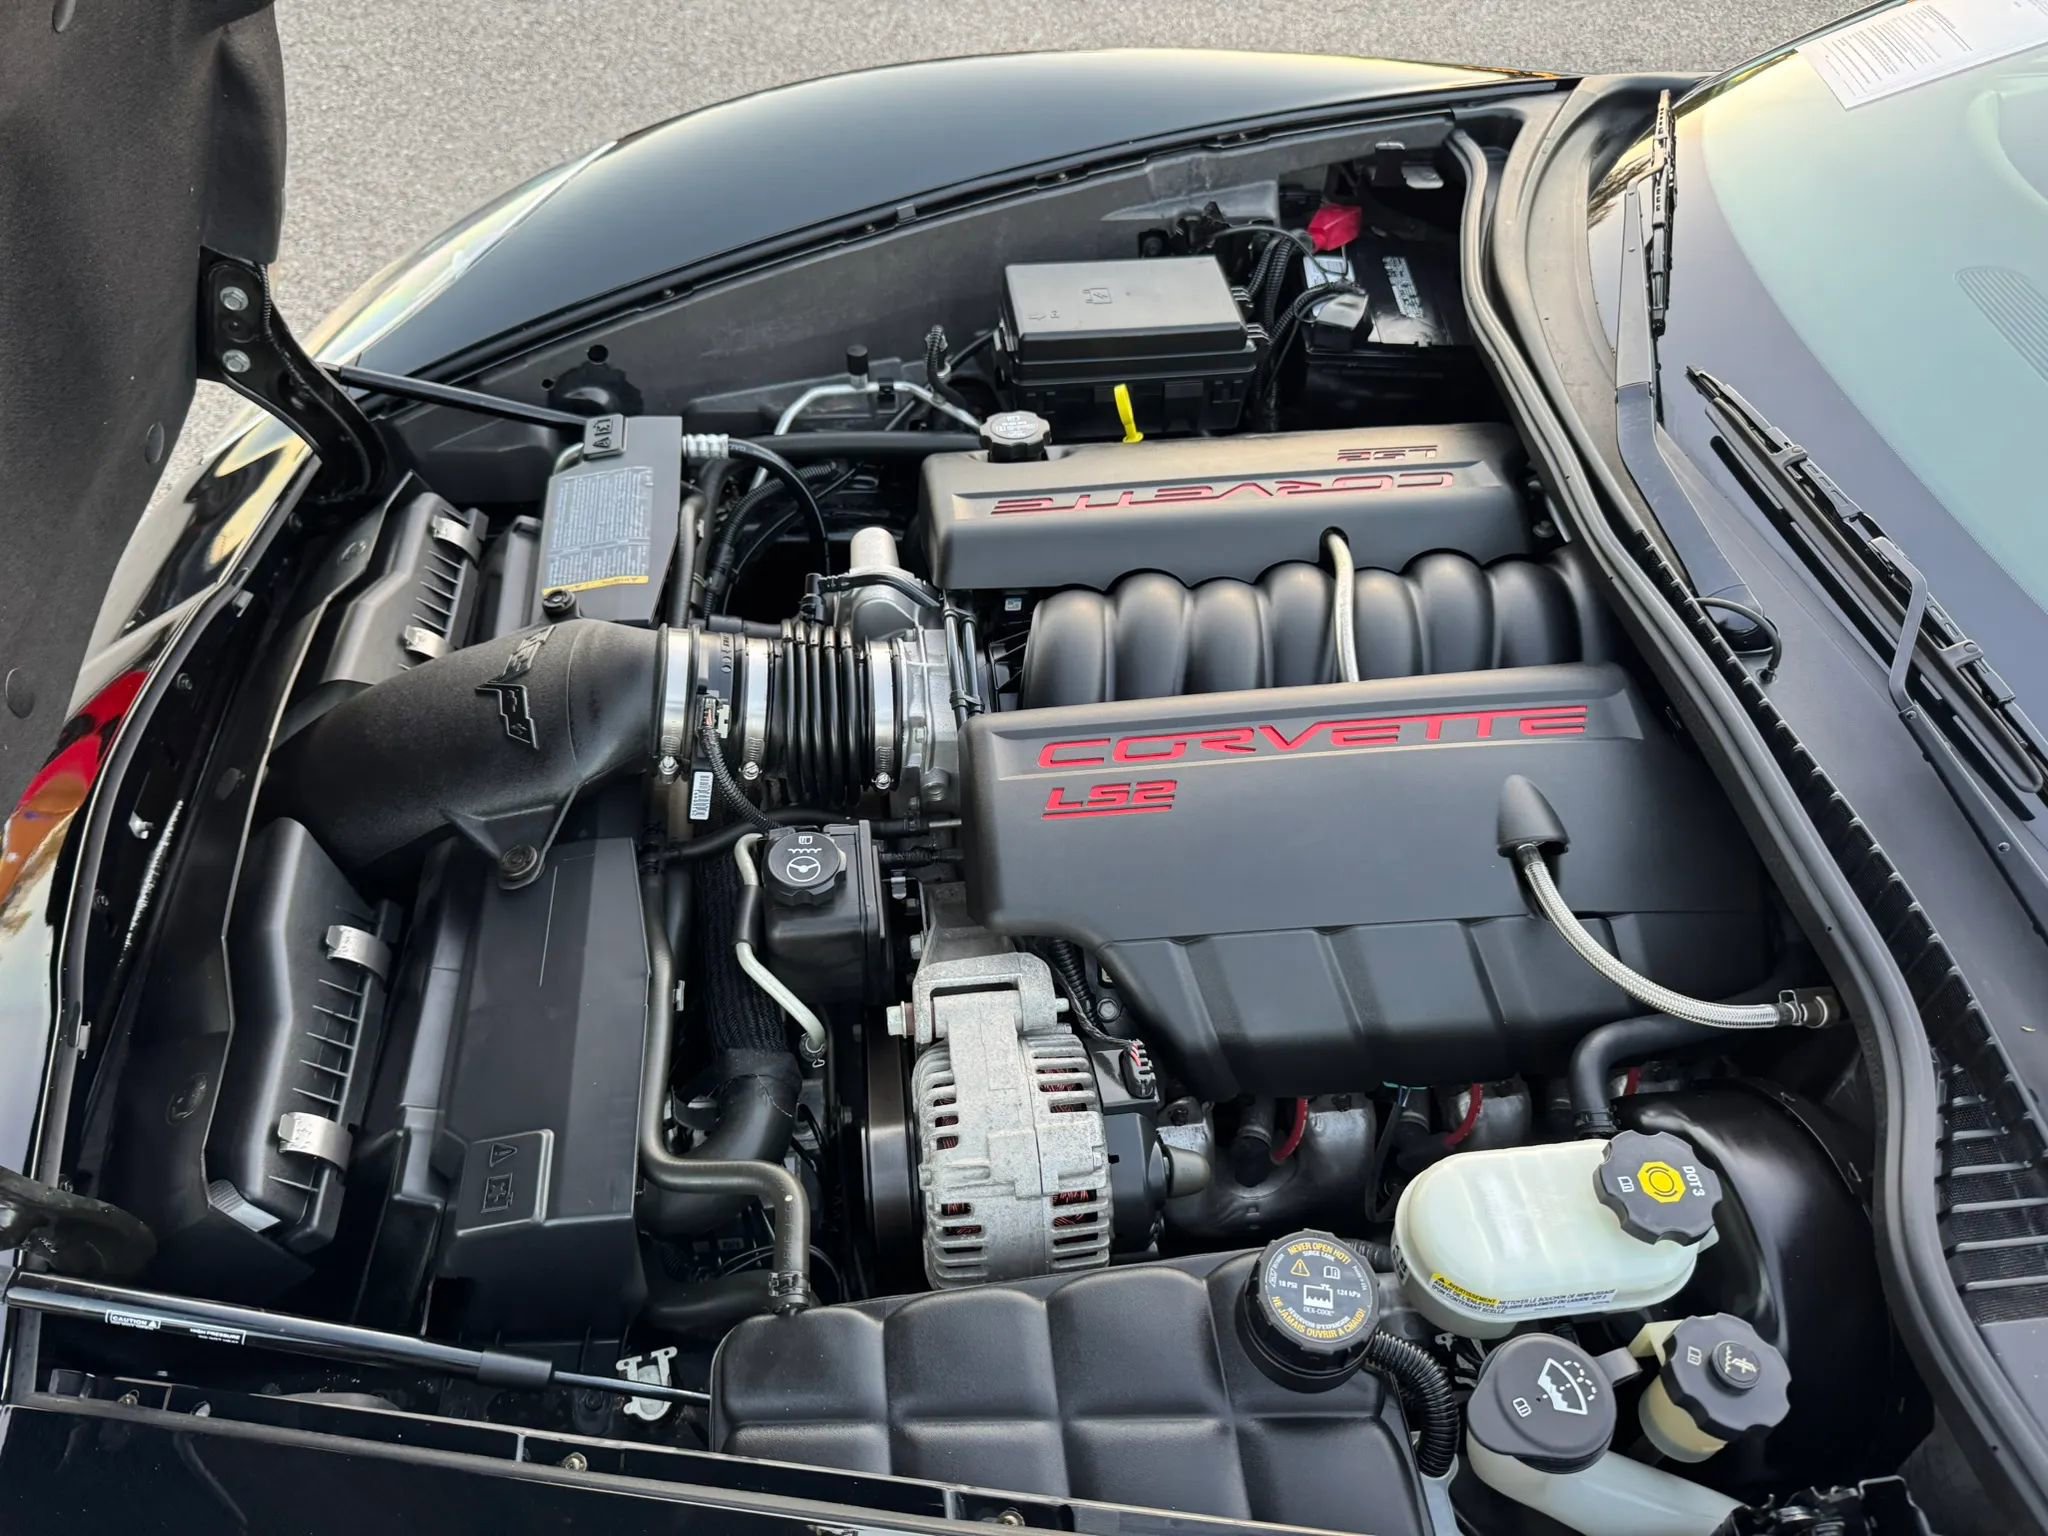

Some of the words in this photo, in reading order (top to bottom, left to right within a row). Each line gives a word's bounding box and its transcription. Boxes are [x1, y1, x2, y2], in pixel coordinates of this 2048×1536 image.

[1337, 447, 1438, 462] LS2
[991, 472, 1454, 514] CORVETTE
[1037, 705, 1588, 768] CORVETTE
[1046, 779, 1177, 812] LS2
[1682, 1165, 1703, 1188] DOT
[1692, 1188, 1706, 1197] 3
[1288, 1242, 1312, 1256] NEVER
[1312, 1242, 1333, 1254] OPEN
[1333, 1250, 1352, 1265] HOT!
[112, 1315, 148, 1326] CAUTION
[1272, 1296, 1284, 1308] NE
[1278, 1308, 1305, 1333] JAMAIS
[1306, 1328, 1337, 1338] OUVRIR
[1344, 1307, 1367, 1332] CHAUD!
[189, 1328, 206, 1336] HIGH
[206, 1330, 241, 1341] PRESSURE
